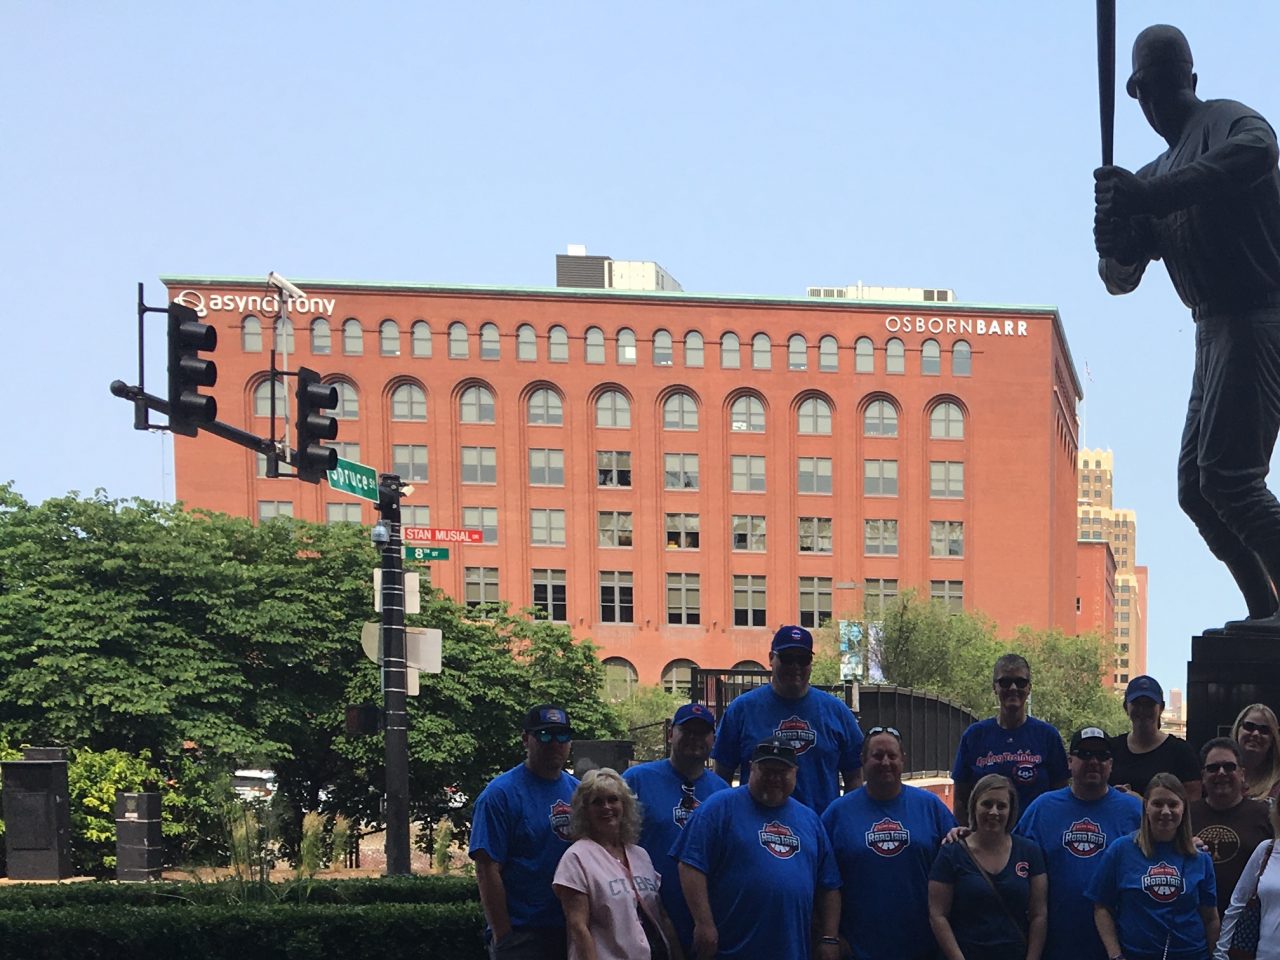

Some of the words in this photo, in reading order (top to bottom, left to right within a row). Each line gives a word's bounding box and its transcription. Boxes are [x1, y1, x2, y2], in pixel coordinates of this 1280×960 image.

[885, 316, 1028, 336] OSBORNBARR
[331, 469, 368, 490] Spruce
[406, 529, 431, 540] STAN
[435, 530, 472, 542] MUSIAL
[868, 832, 891, 843] ROAD
[1065, 832, 1088, 843] ROAD
[1015, 861, 1030, 878] C
[1144, 876, 1167, 887] ROAD
